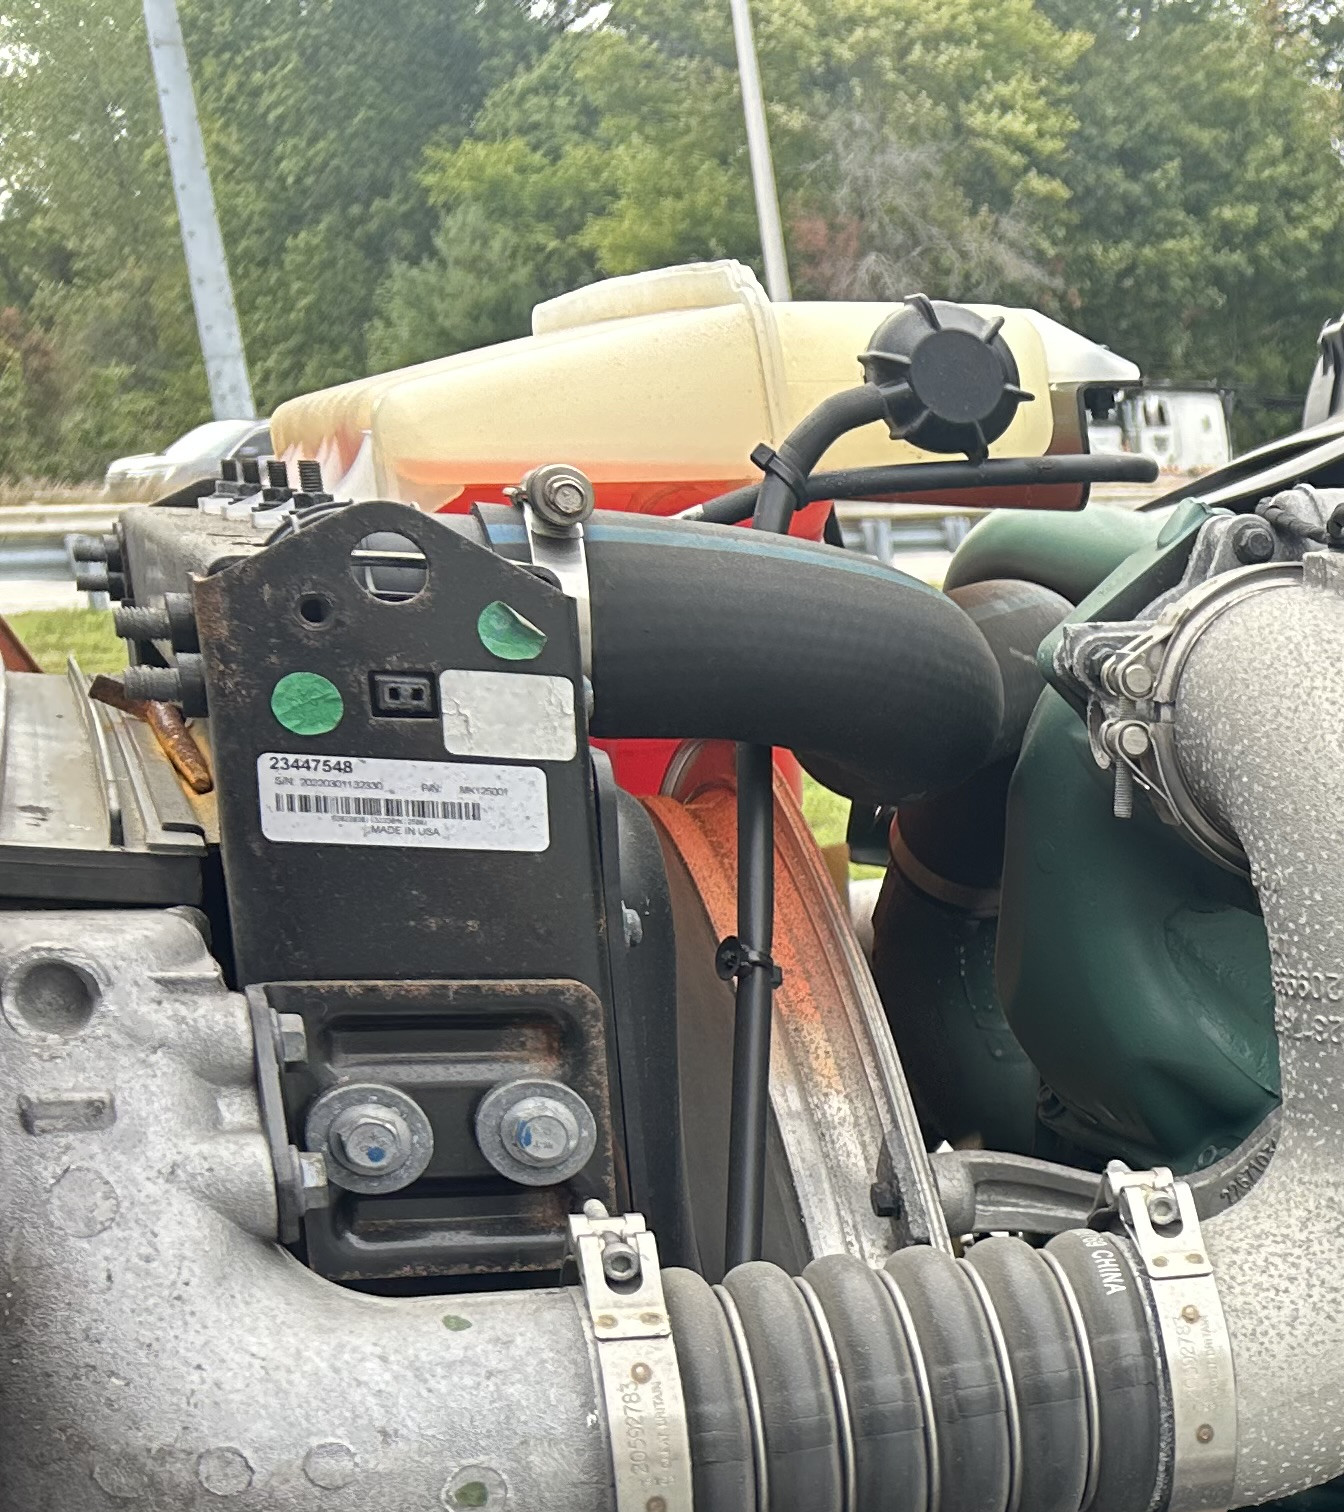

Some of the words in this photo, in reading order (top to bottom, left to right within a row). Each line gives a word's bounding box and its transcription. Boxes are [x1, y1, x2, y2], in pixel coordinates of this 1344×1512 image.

[270, 756, 353, 774] 23447548
[370, 824, 402, 836] MADE
[404, 826, 416, 836] IN
[417, 826, 440, 837] USA
[617, 1381, 649, 1473] 20592783
